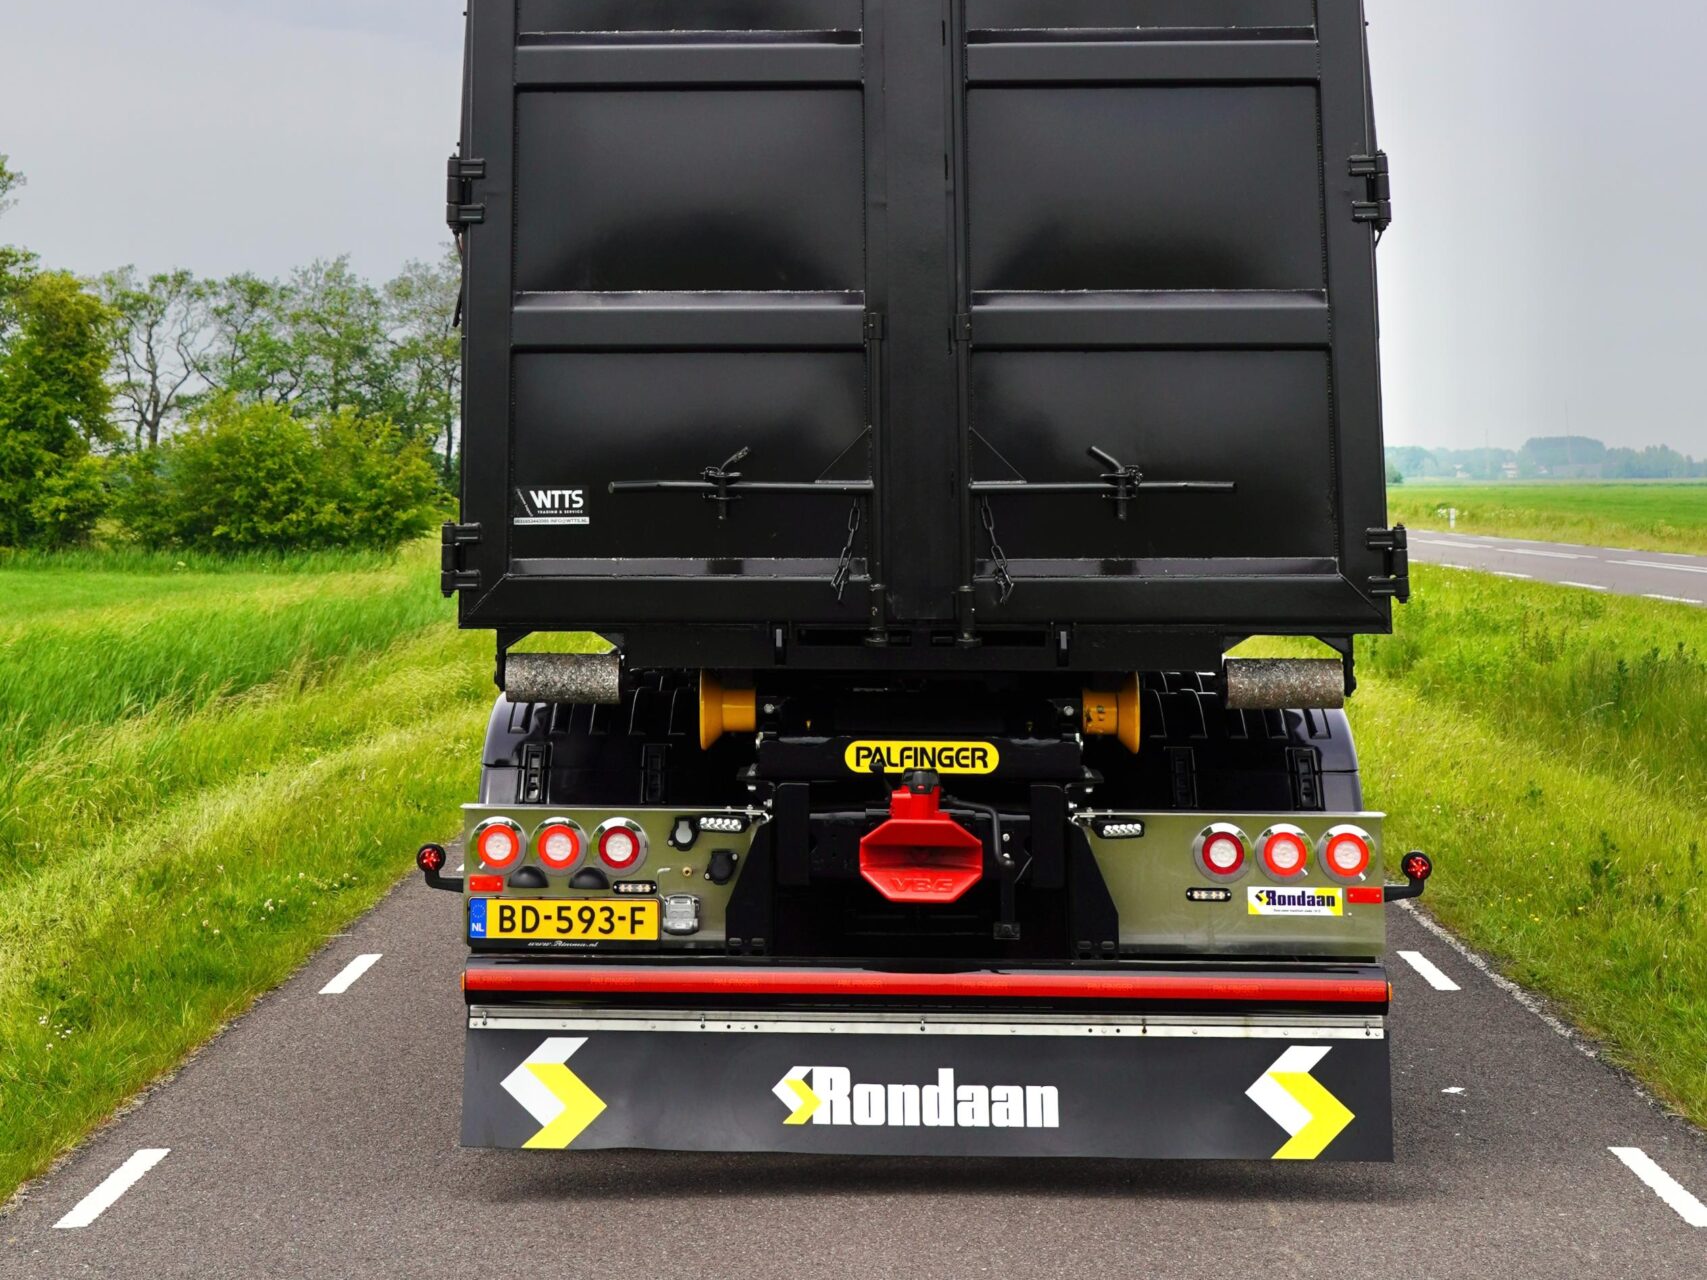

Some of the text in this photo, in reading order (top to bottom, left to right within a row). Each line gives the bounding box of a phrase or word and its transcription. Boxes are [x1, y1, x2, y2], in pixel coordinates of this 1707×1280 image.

[529, 489, 584, 509] WTTS
[855, 746, 988, 769] PALFINGER
[1265, 890, 1336, 907] Rondaan
[471, 922, 485, 932] NL
[499, 905, 646, 934] BD-593-F
[812, 1066, 1059, 1127] Rondaan
